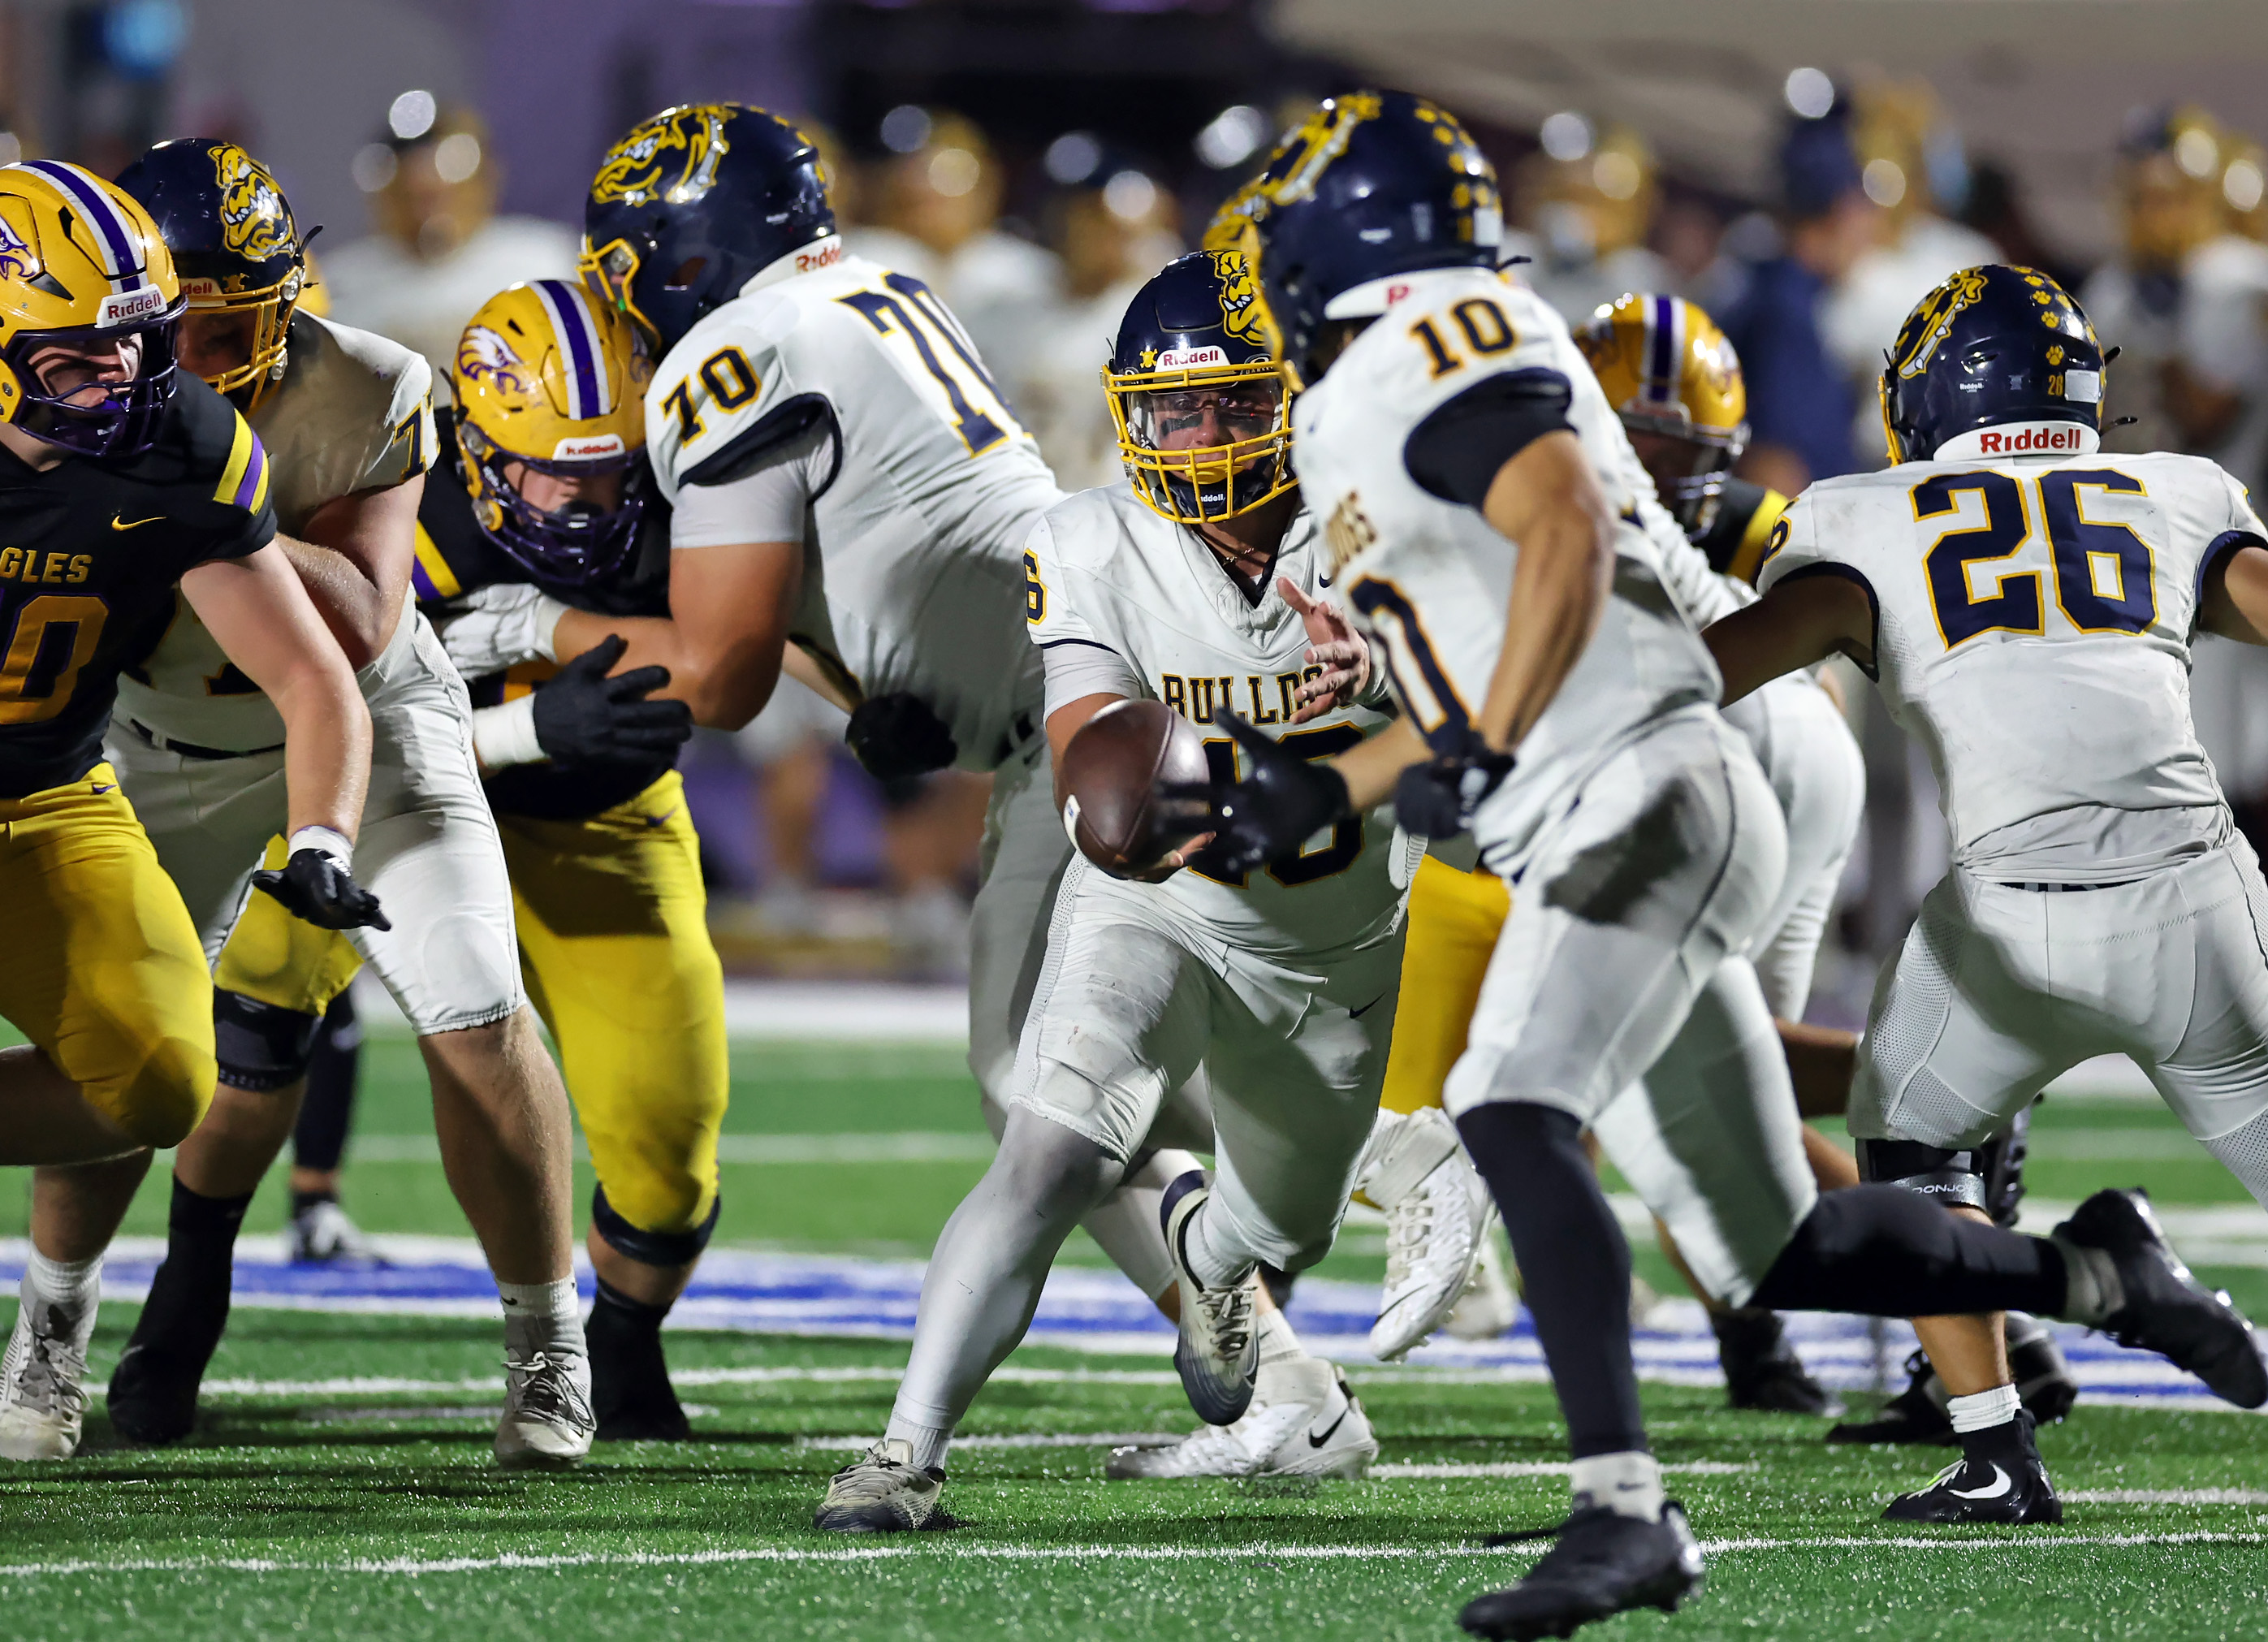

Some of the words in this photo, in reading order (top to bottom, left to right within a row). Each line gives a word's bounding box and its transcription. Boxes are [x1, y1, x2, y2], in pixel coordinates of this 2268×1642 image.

[795, 244, 841, 273] Ridd
[180, 283, 213, 296] dell
[107, 293, 162, 319] Riddell
[1408, 297, 1521, 378] 10
[1163, 349, 1220, 367] Riddell
[659, 344, 762, 450] 70
[1980, 428, 2081, 454] Riddell
[1908, 468, 2160, 653] 26
